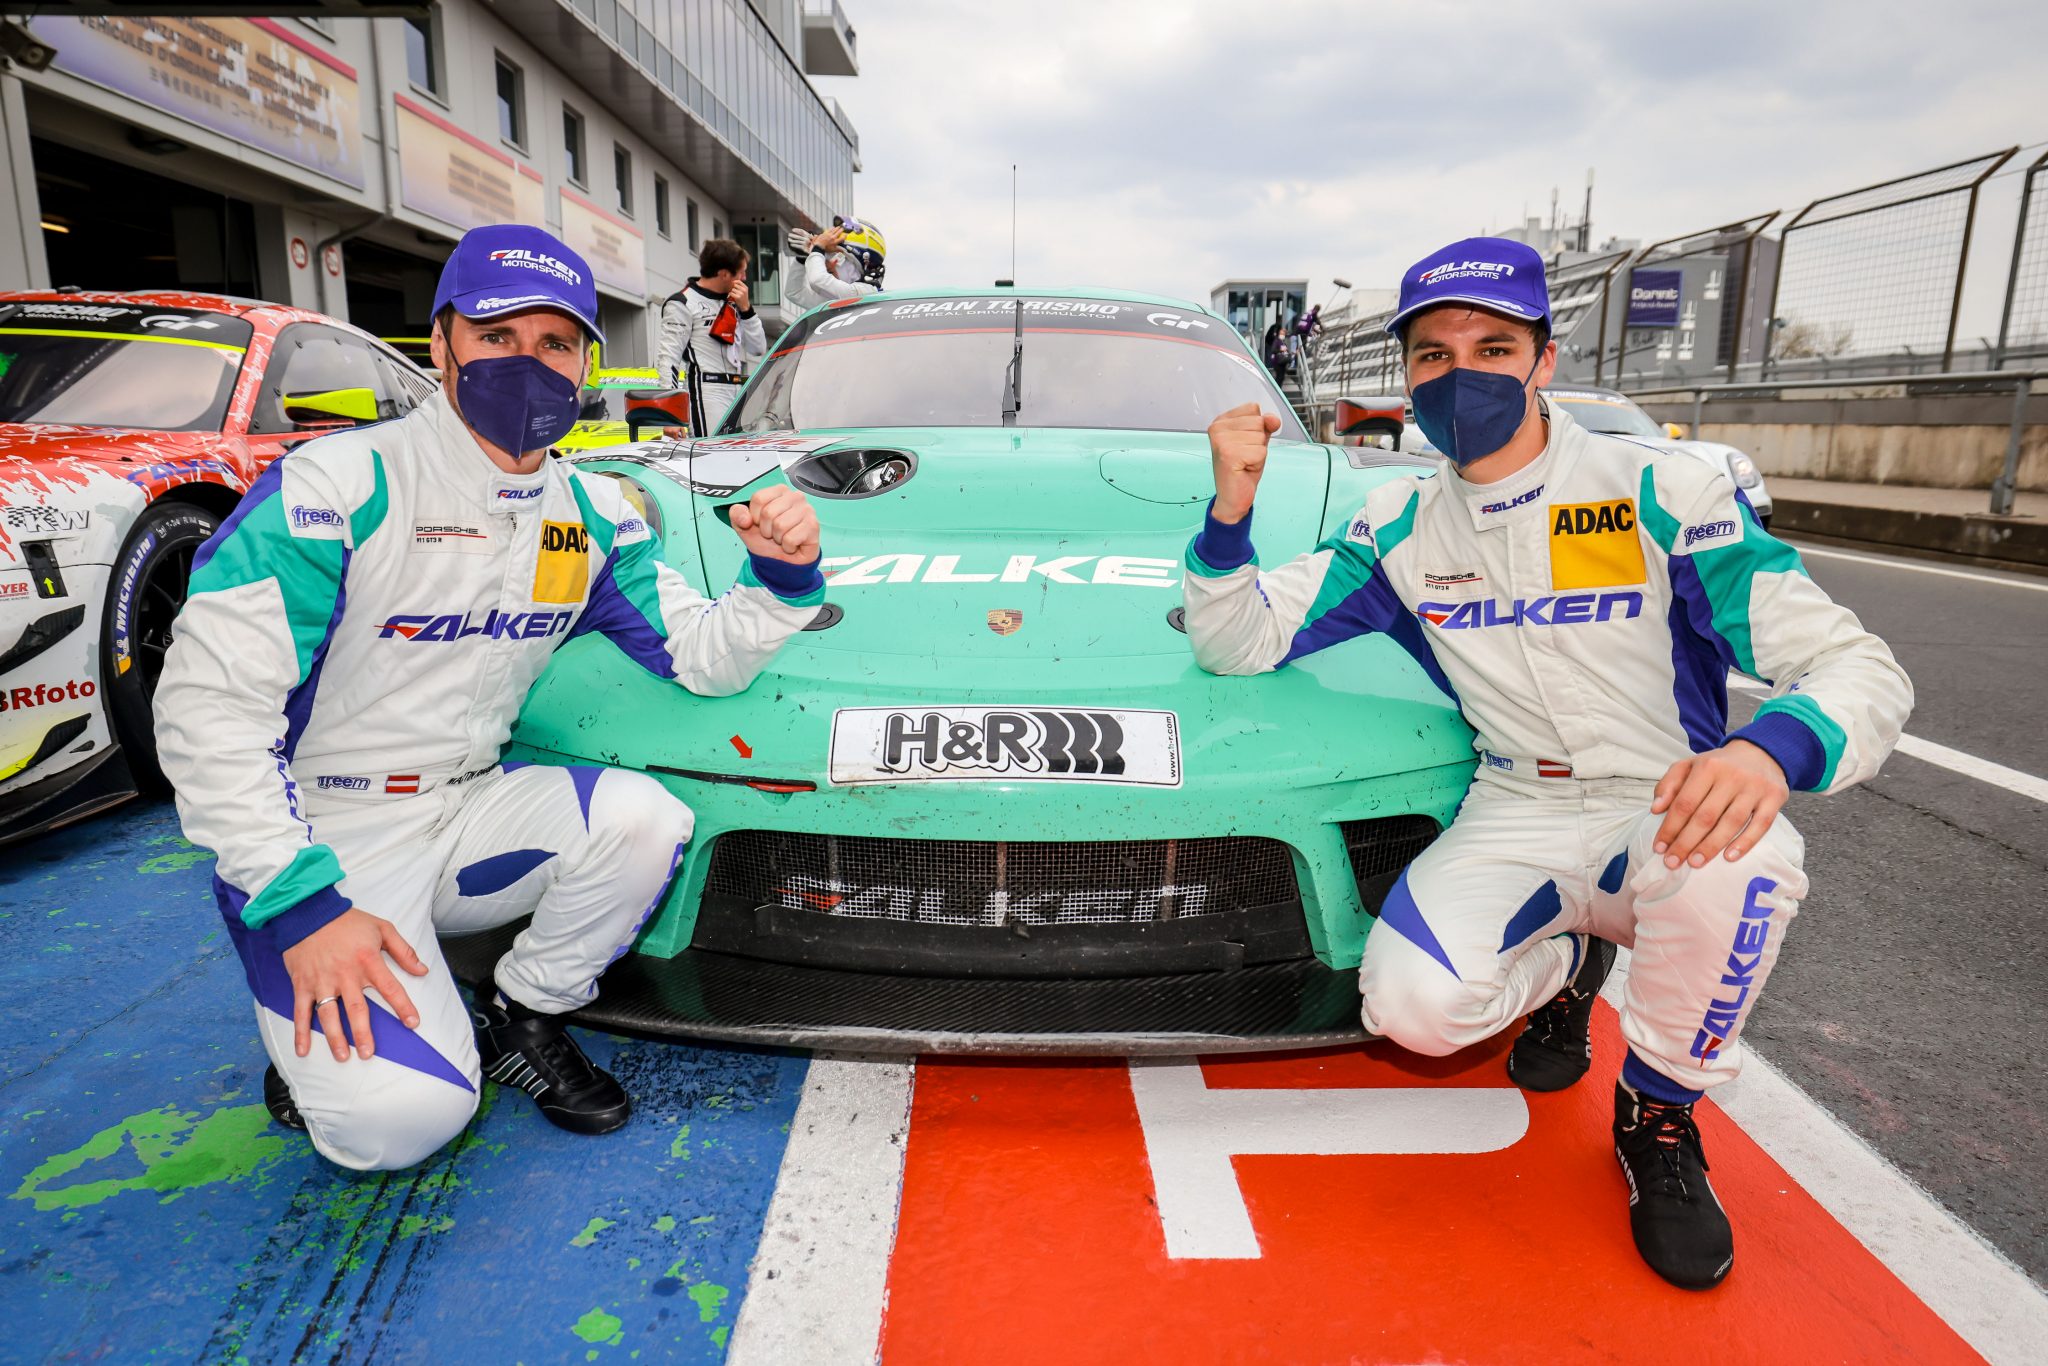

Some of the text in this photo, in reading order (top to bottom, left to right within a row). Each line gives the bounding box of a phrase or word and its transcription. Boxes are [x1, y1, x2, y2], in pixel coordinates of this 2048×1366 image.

[486, 249, 581, 285] FALKEN
[502, 260, 574, 286] MOTORSPORTS
[1419, 261, 1515, 283] FALKEN
[1427, 271, 1500, 286] MOTORSPORTS
[892, 301, 978, 316] GRAN
[967, 309, 1026, 317] DRIVIN
[1031, 310, 1116, 320] SIMULATOR
[1480, 484, 1546, 514] FALKEN
[416, 526, 479, 534] PORSCHE
[1553, 502, 1634, 537] ADAC
[541, 524, 589, 553] ADAC
[115, 535, 153, 632] MICHELIN
[819, 554, 1186, 590] FALKE
[1425, 572, 1476, 581] PORSCHE
[373, 609, 573, 642] FALKEN
[1413, 591, 1643, 630] FALKEN
[886, 713, 1040, 772] H&R
[1689, 876, 1778, 1067] FALKEN
